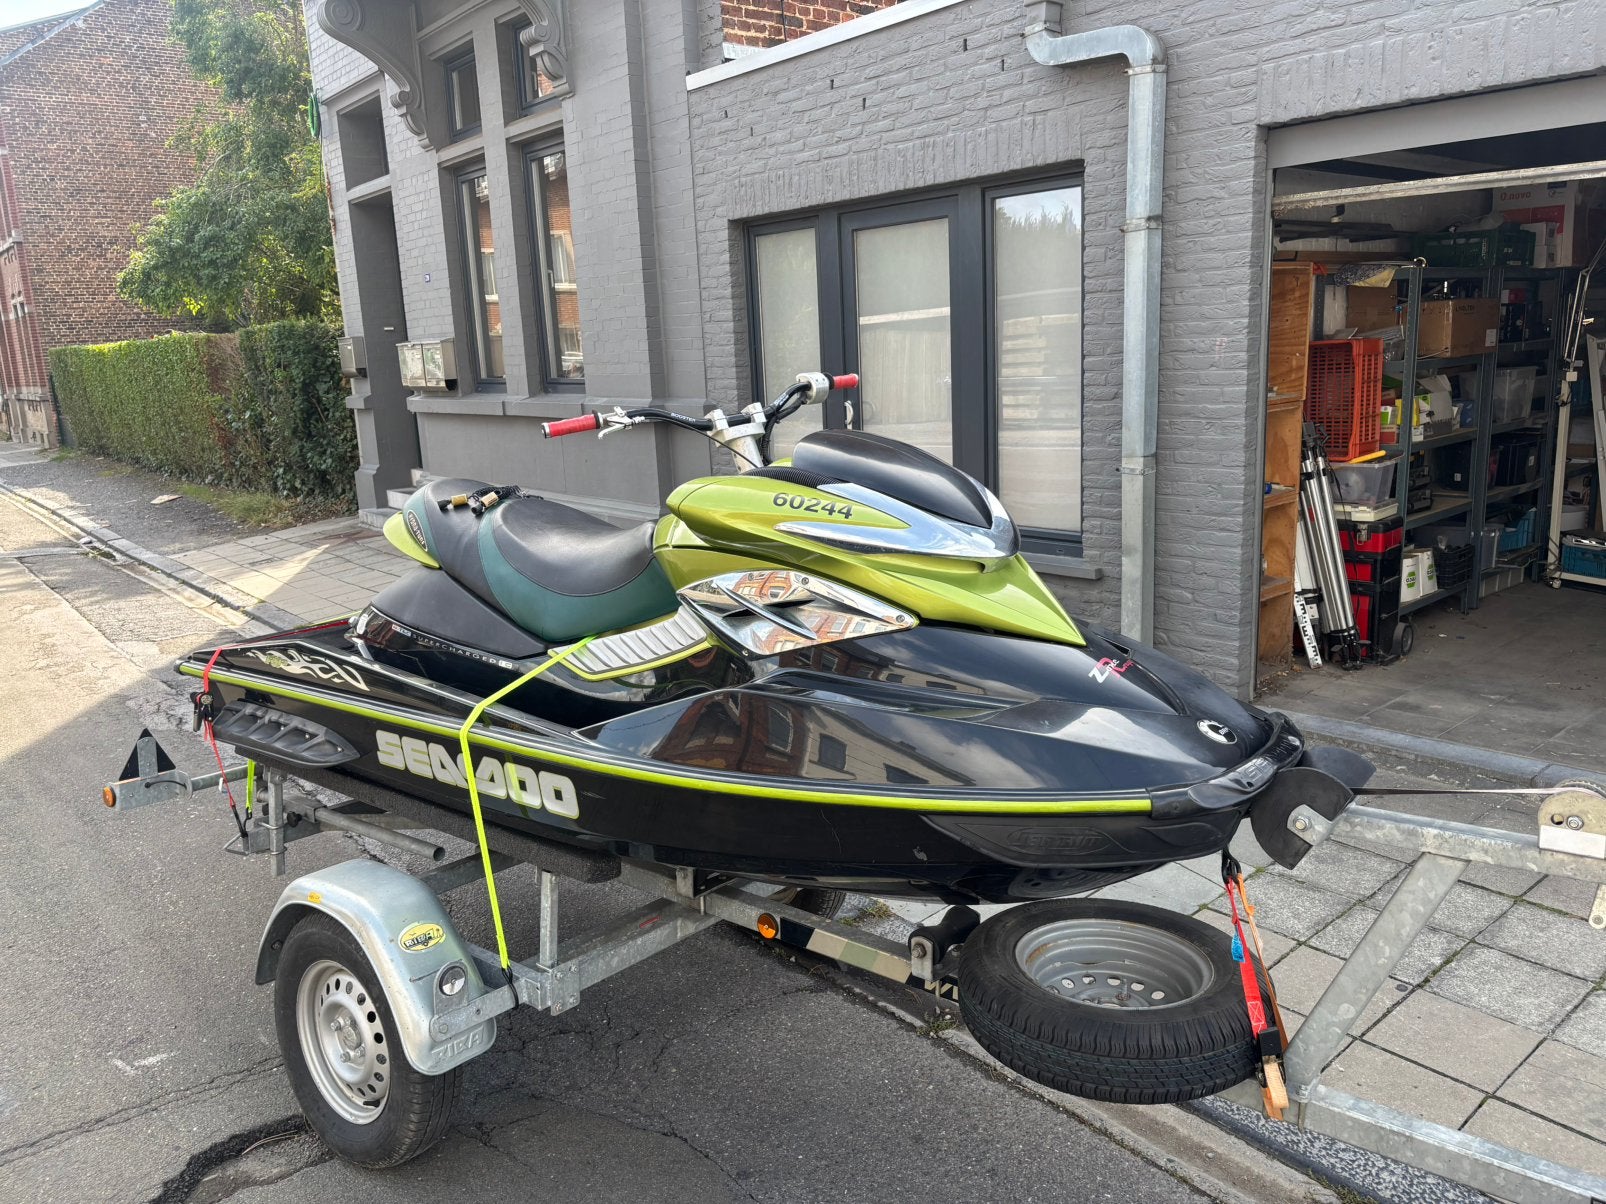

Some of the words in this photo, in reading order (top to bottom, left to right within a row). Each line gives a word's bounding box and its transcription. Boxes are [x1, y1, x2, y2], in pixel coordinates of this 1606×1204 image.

[670, 411, 696, 423] BOOSTER
[772, 492, 853, 520] 60244
[412, 632, 497, 664] SUPERCHARGED
